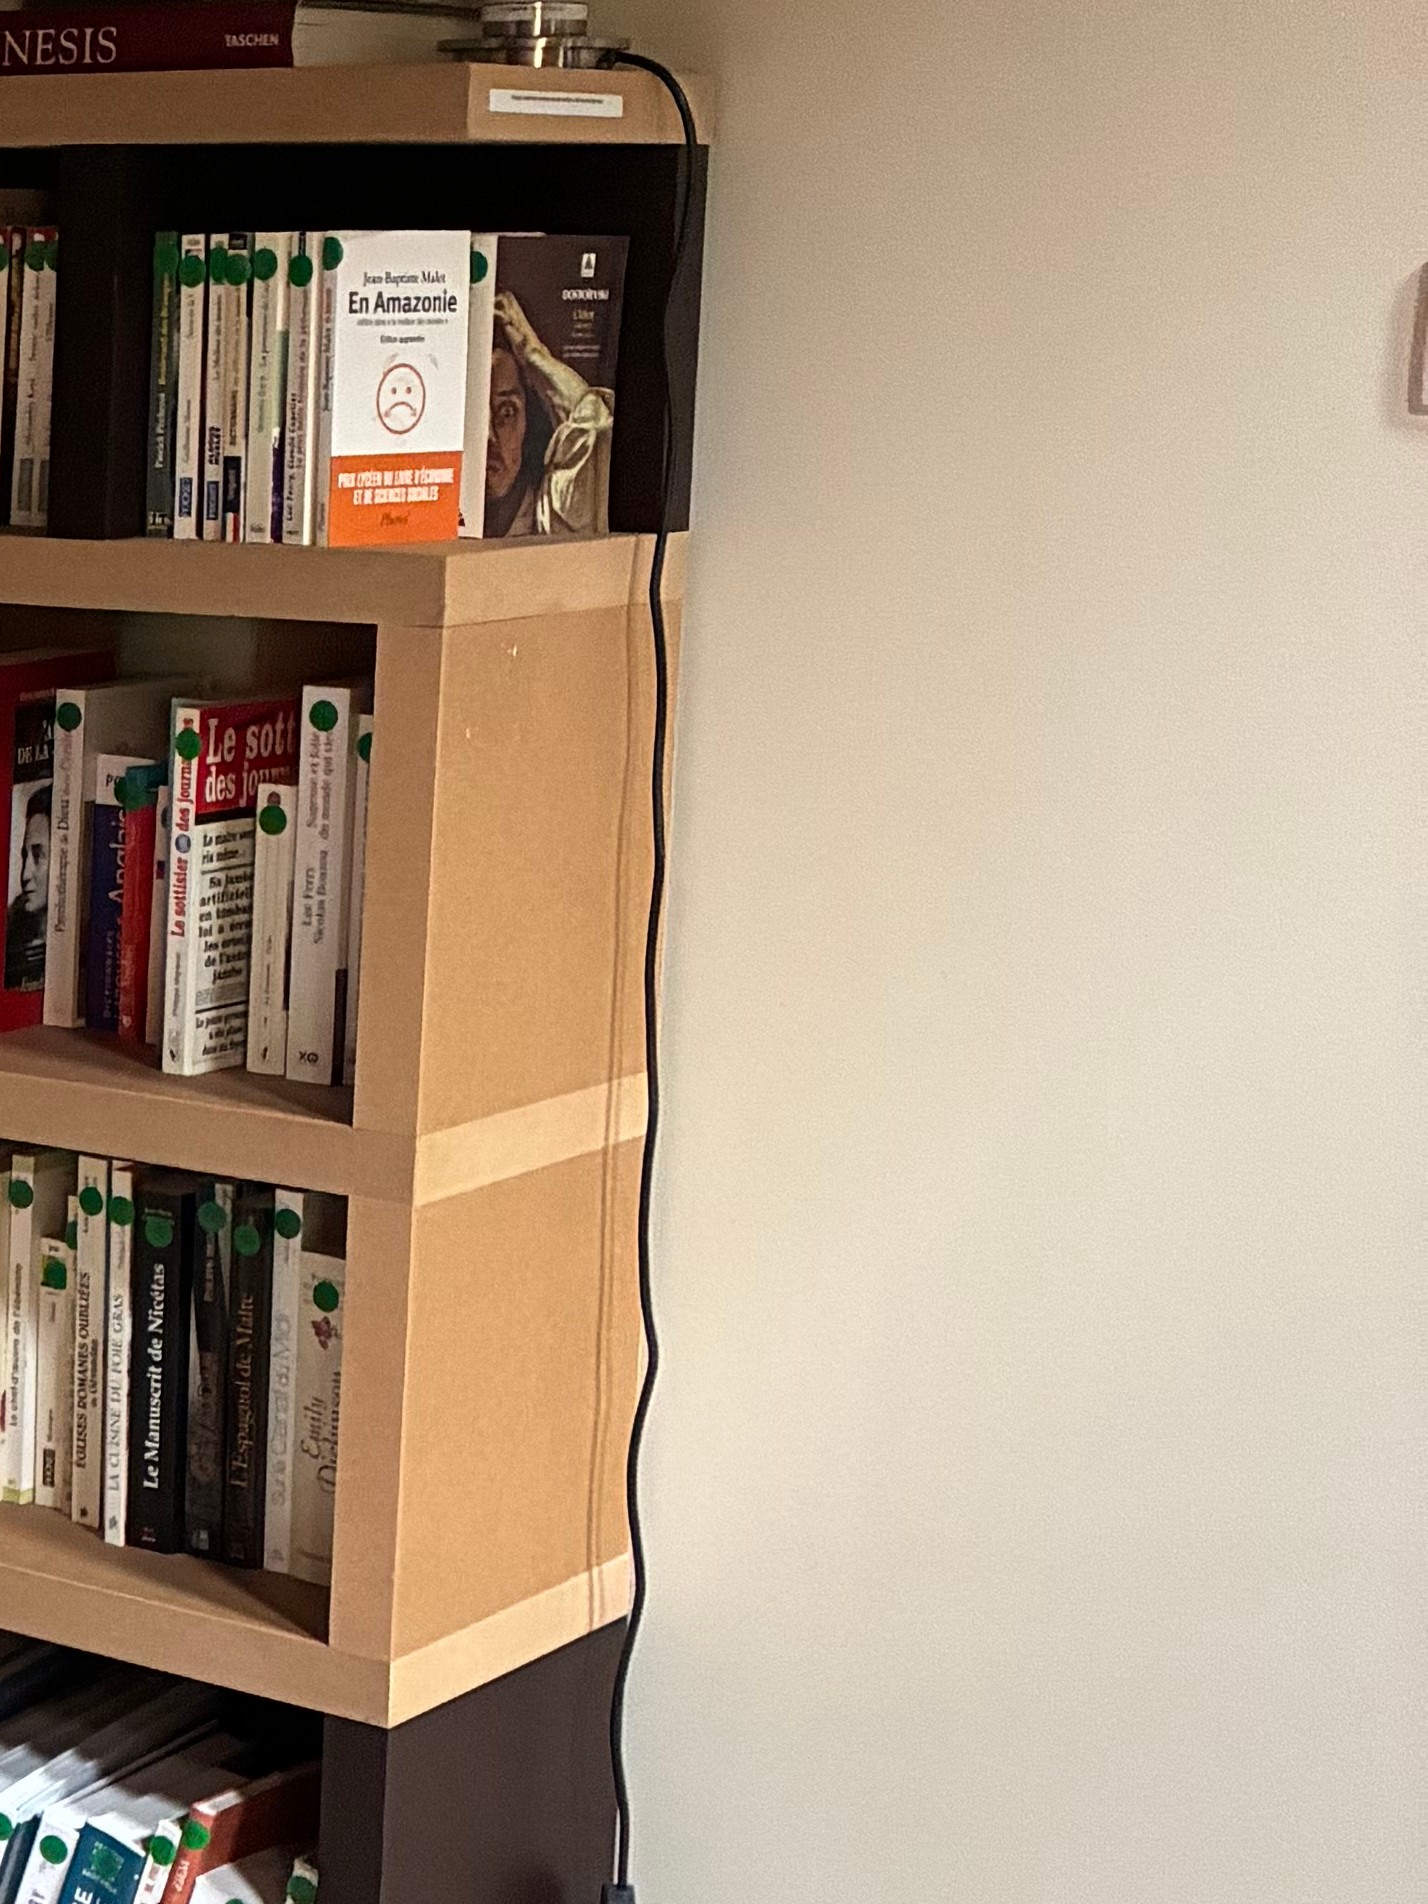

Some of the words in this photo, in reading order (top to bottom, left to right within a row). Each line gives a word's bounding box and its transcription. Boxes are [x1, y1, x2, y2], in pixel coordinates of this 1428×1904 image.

[225, 33, 279, 48] TASCHEN
[349, 291, 370, 314] En
[374, 288, 458, 314] Amazonie
[206, 717, 237, 765] Le
[205, 768, 236, 804] des
[56, 799, 69, 831] Dieu
[175, 807, 189, 831] des
[171, 857, 188, 917] sottisier
[302, 867, 317, 904] Ferry
[171, 920, 186, 937] Le
[302, 906, 313, 926] Luc
[76, 1271, 91, 1340] OUBLIÉES
[112, 1293, 124, 1334] GRAS
[147, 1263, 166, 1335] Nicétas
[110, 1339, 123, 1374] FOIE
[146, 1338, 162, 1361] de
[236, 1354, 252, 1377] de
[75, 1341, 88, 1410] ROMANES
[109, 1379, 122, 1404] DU
[143, 1365, 162, 1462] Manuscrit
[300, 1396, 326, 1459] Emily
[74, 1412, 88, 1468] ÉGLISES
[108, 1473, 120, 1492] LA
[143, 1465, 160, 1489] Le
